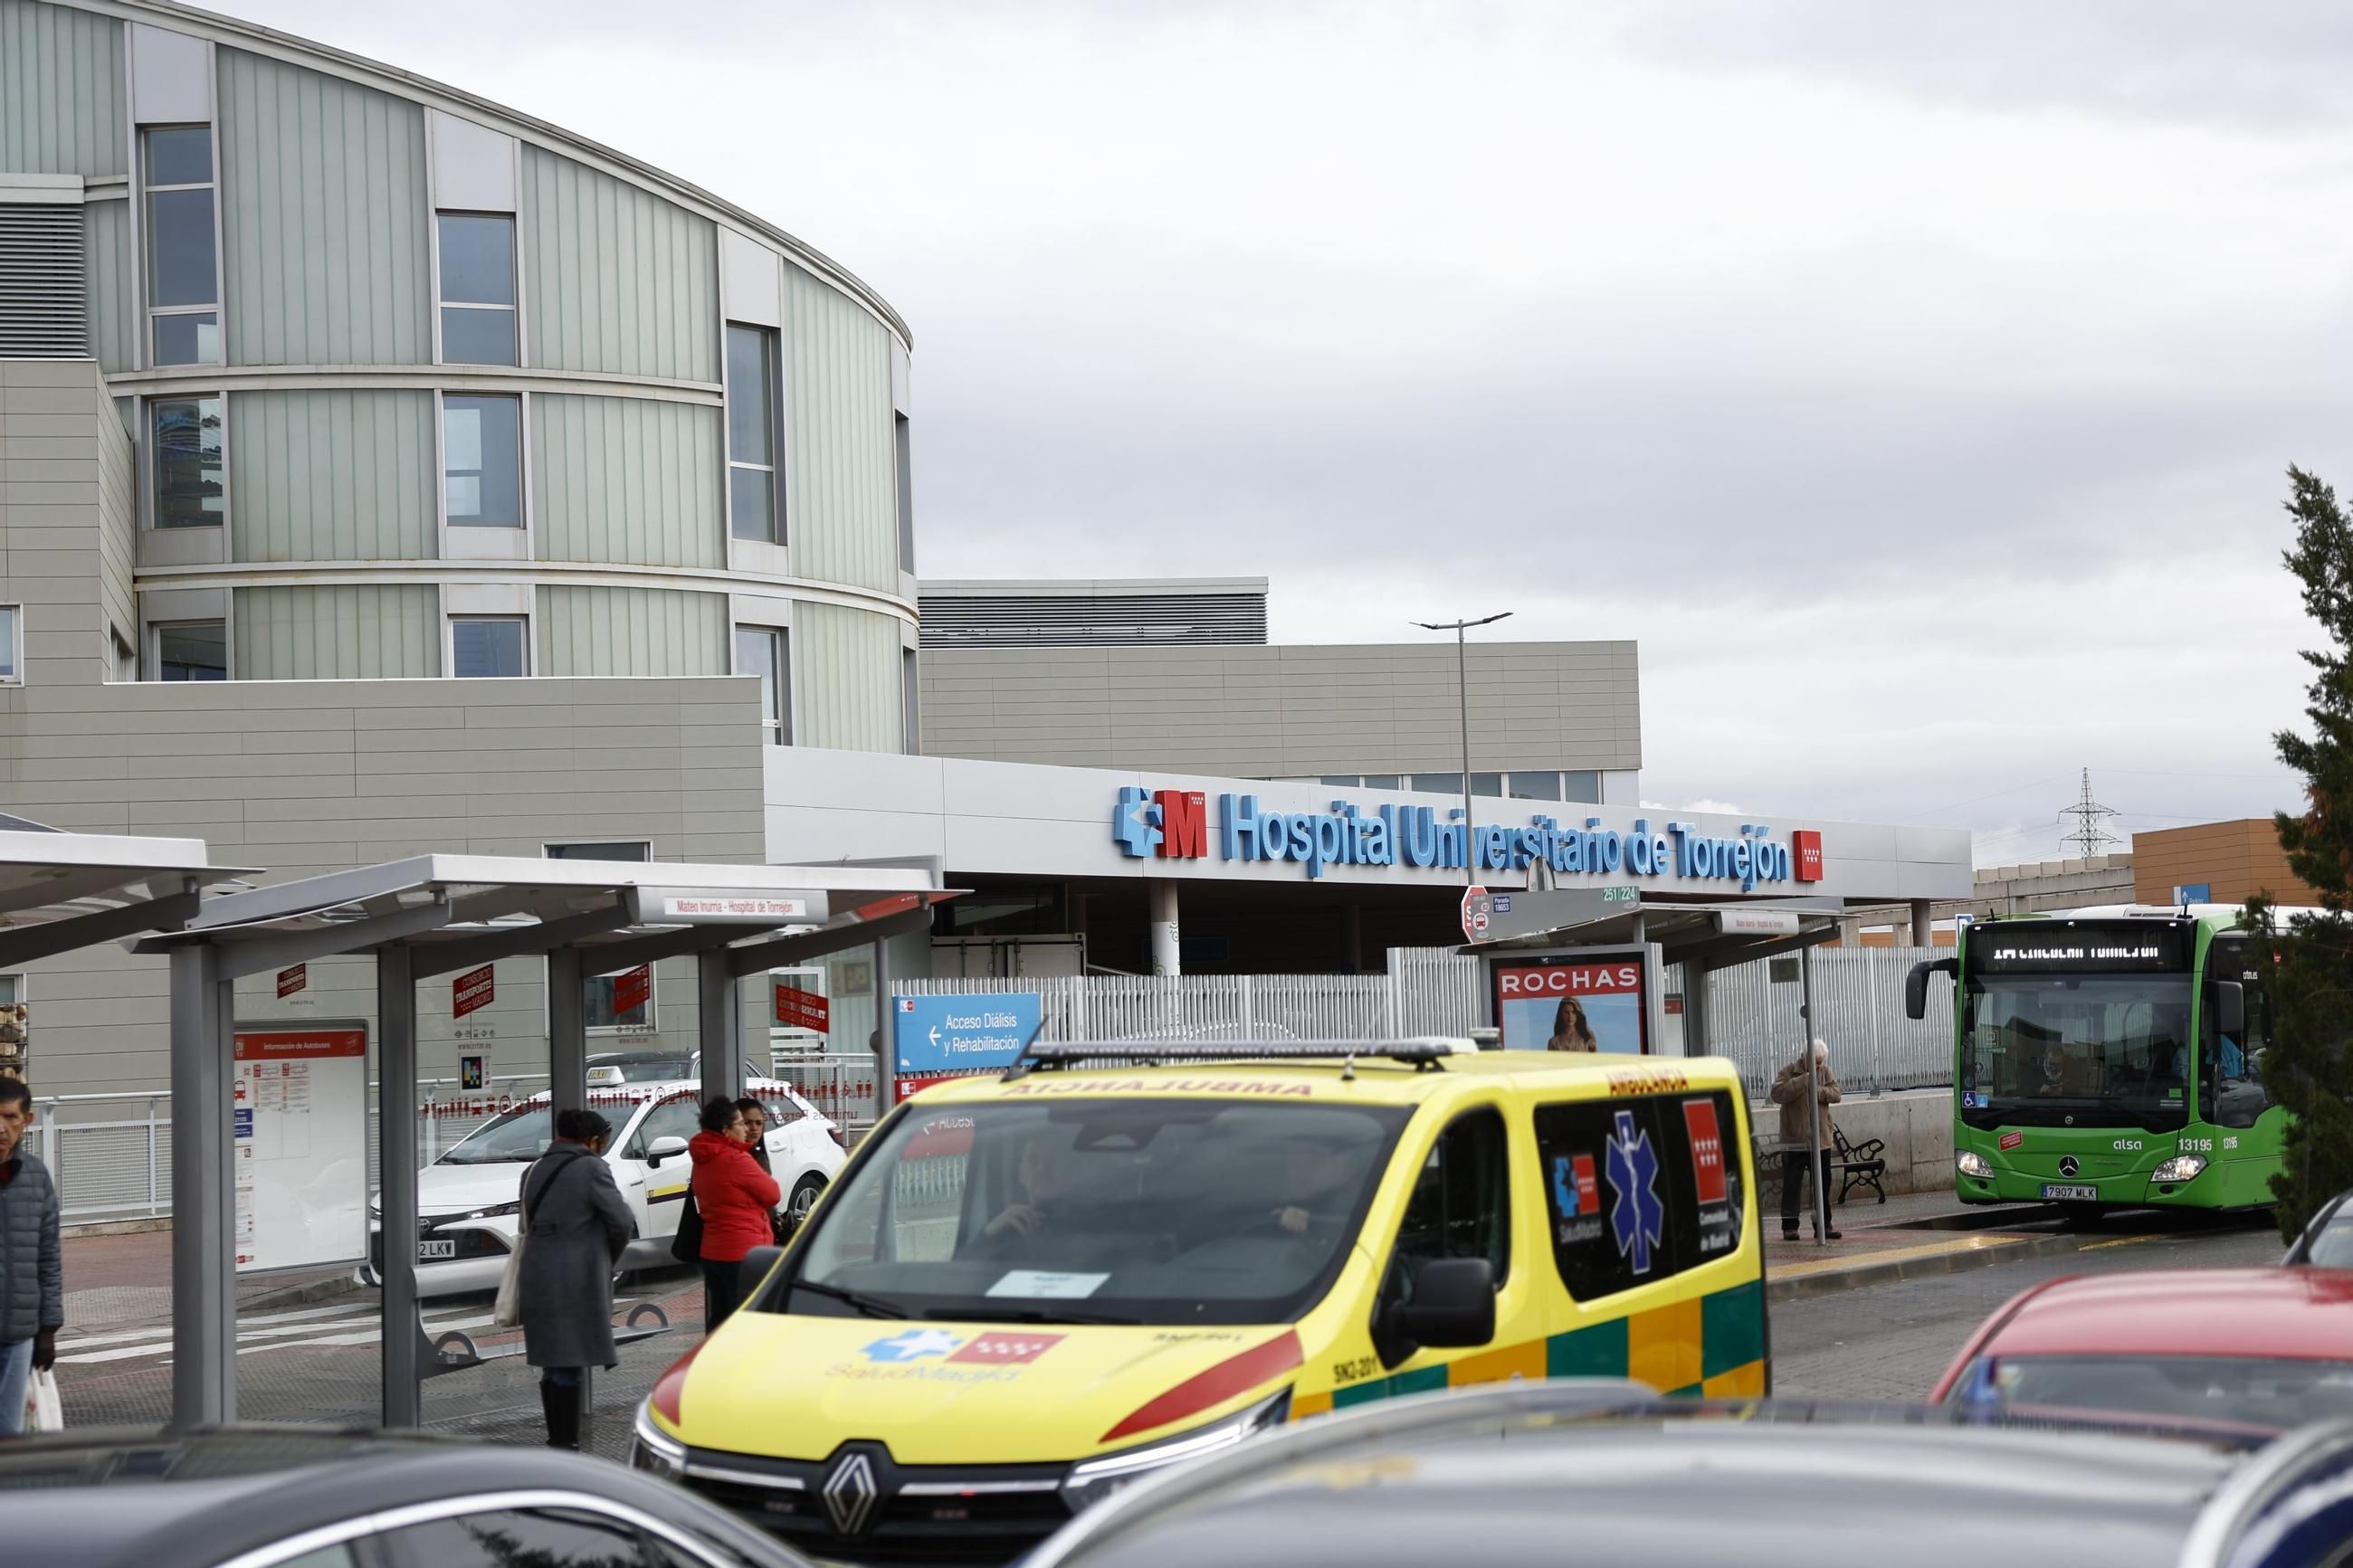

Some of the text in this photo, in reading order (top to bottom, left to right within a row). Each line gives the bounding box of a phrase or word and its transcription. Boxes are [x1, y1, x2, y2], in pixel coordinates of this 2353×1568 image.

[1221, 793, 1789, 892] Hospital Universitario de Torrejón
[1603, 887, 1635, 901] 251 224
[676, 899, 699, 913] Mateo
[729, 901, 755, 916] Hospital
[757, 903, 766, 913] de
[767, 901, 793, 916] Torrejón
[1501, 967, 1637, 993] ROCHAS
[455, 979, 492, 1003] TRANSPORTES
[946, 1012, 1017, 1030] Acceso Diálisis
[944, 1035, 1020, 1057] y Rehabilitación
[589, 1069, 607, 1079] TAXI
[2113, 1140, 2142, 1150] alsa
[2178, 1138, 2212, 1151] 13195
[2223, 1136, 2238, 1150] 13195
[2048, 1187, 2095, 1200] 7907 MLK
[429, 1242, 452, 1255] LKW
